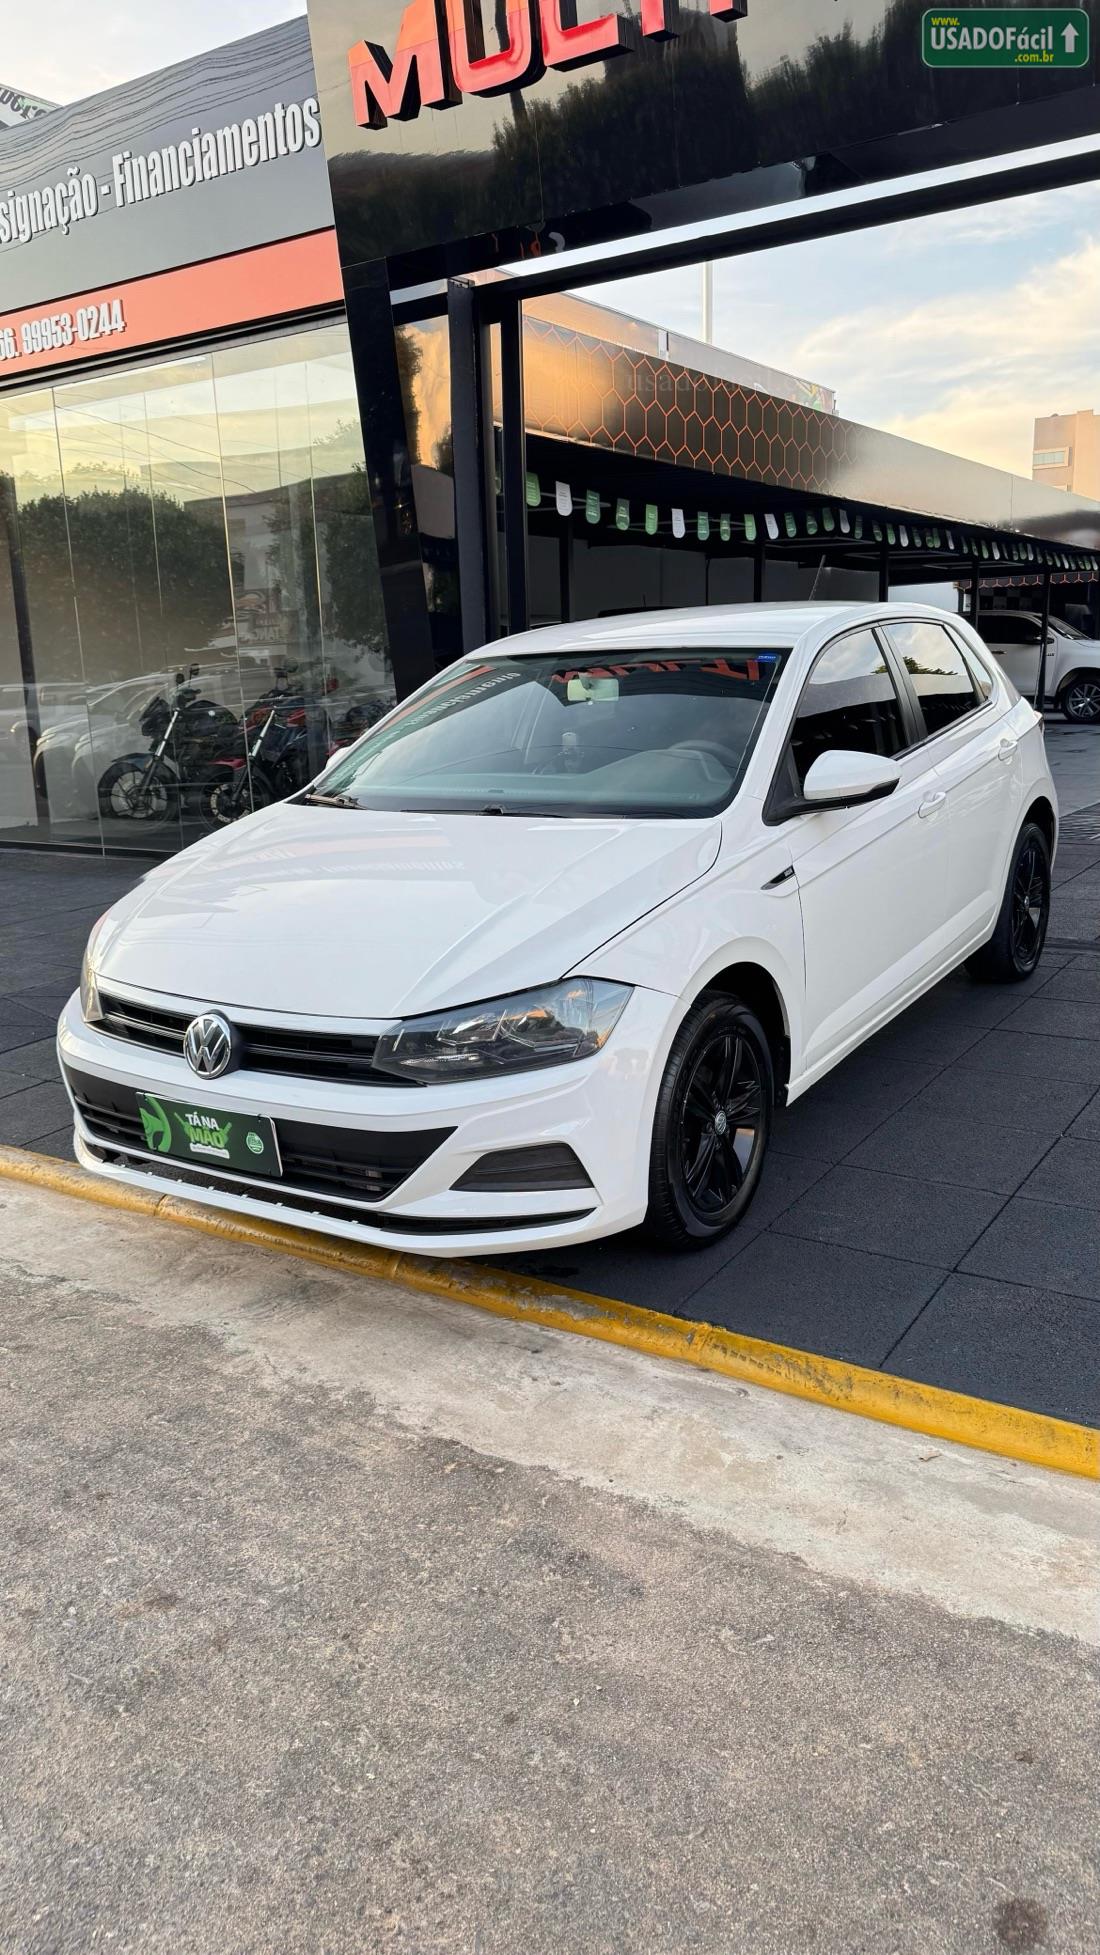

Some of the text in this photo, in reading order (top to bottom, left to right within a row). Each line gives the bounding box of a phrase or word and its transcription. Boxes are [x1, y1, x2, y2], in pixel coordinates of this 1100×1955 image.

[348, 0, 748, 130] MUL
[112, 97, 322, 208] Financiamentos
[21, 298, 126, 354] 99953-0244
[185, 1111, 220, 1131] TÁ NA
